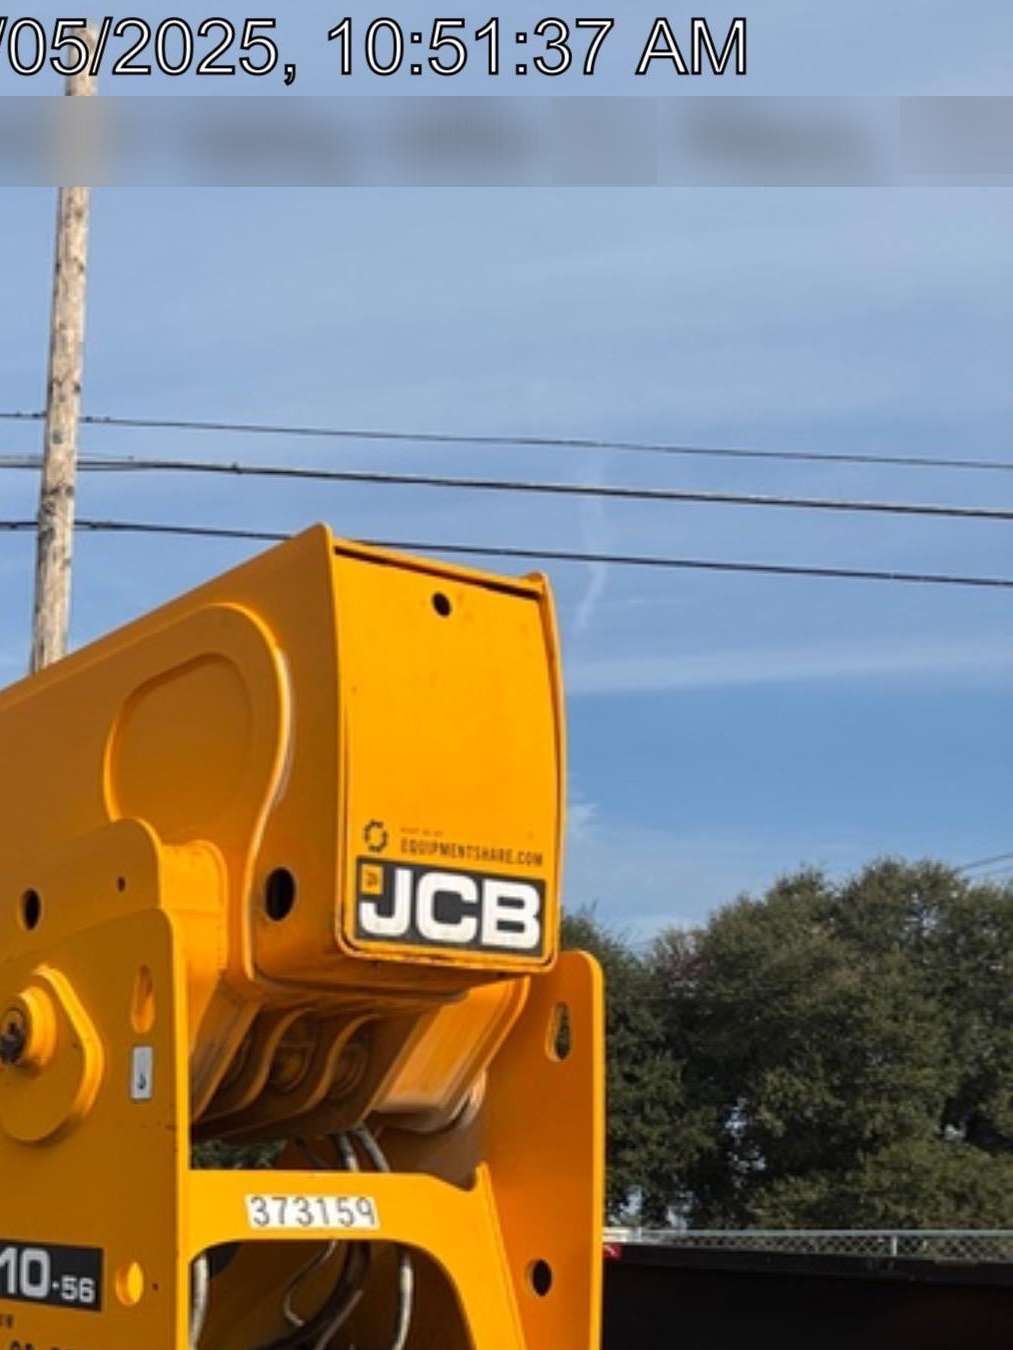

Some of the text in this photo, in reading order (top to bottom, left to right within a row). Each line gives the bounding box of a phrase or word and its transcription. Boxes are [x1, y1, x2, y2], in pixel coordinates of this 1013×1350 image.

[400, 837, 543, 867] EQUIPMENTSHARE.COM
[359, 867, 541, 949] JCB
[250, 1195, 375, 1227] 373159
